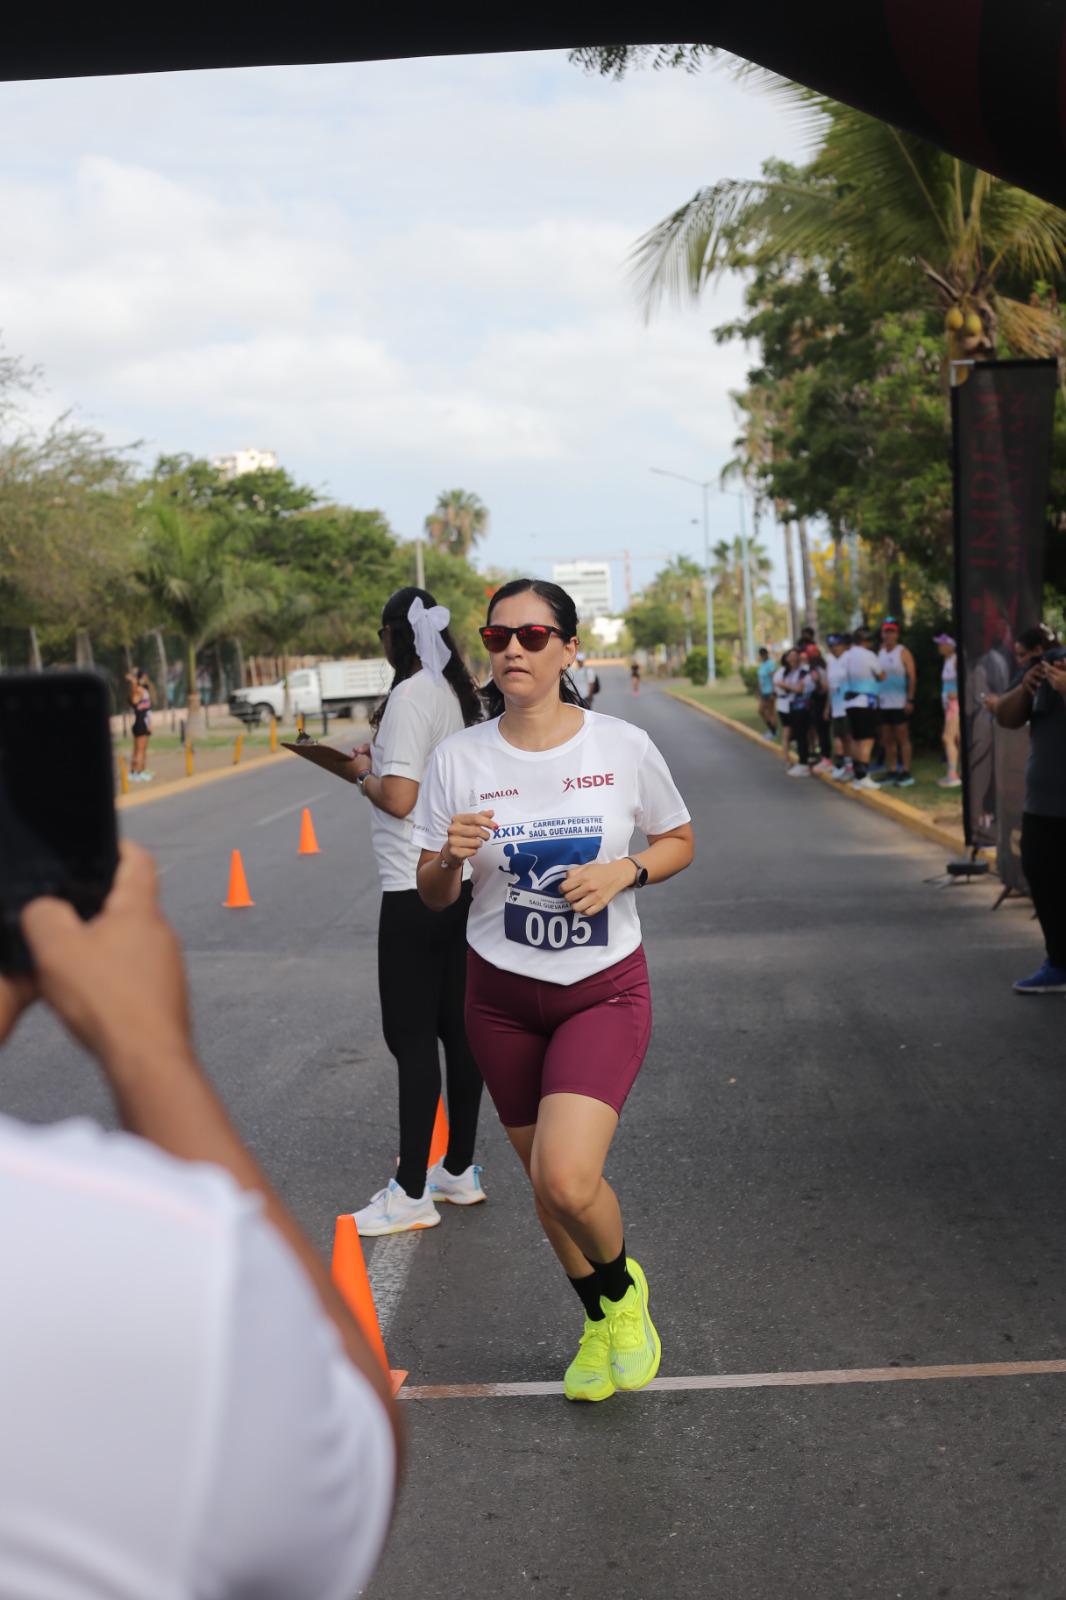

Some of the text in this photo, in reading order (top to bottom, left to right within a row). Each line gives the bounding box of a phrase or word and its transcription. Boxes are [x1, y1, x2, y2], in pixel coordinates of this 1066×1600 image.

[577, 773, 615, 789] ISDE
[480, 788, 519, 801] SINALOA
[533, 817, 603, 828] CARRERA PEDESTRE
[493, 825, 526, 839] XXIX
[528, 825, 603, 838] SAÚL GUEVARA NAVA
[525, 911, 592, 949] 005
